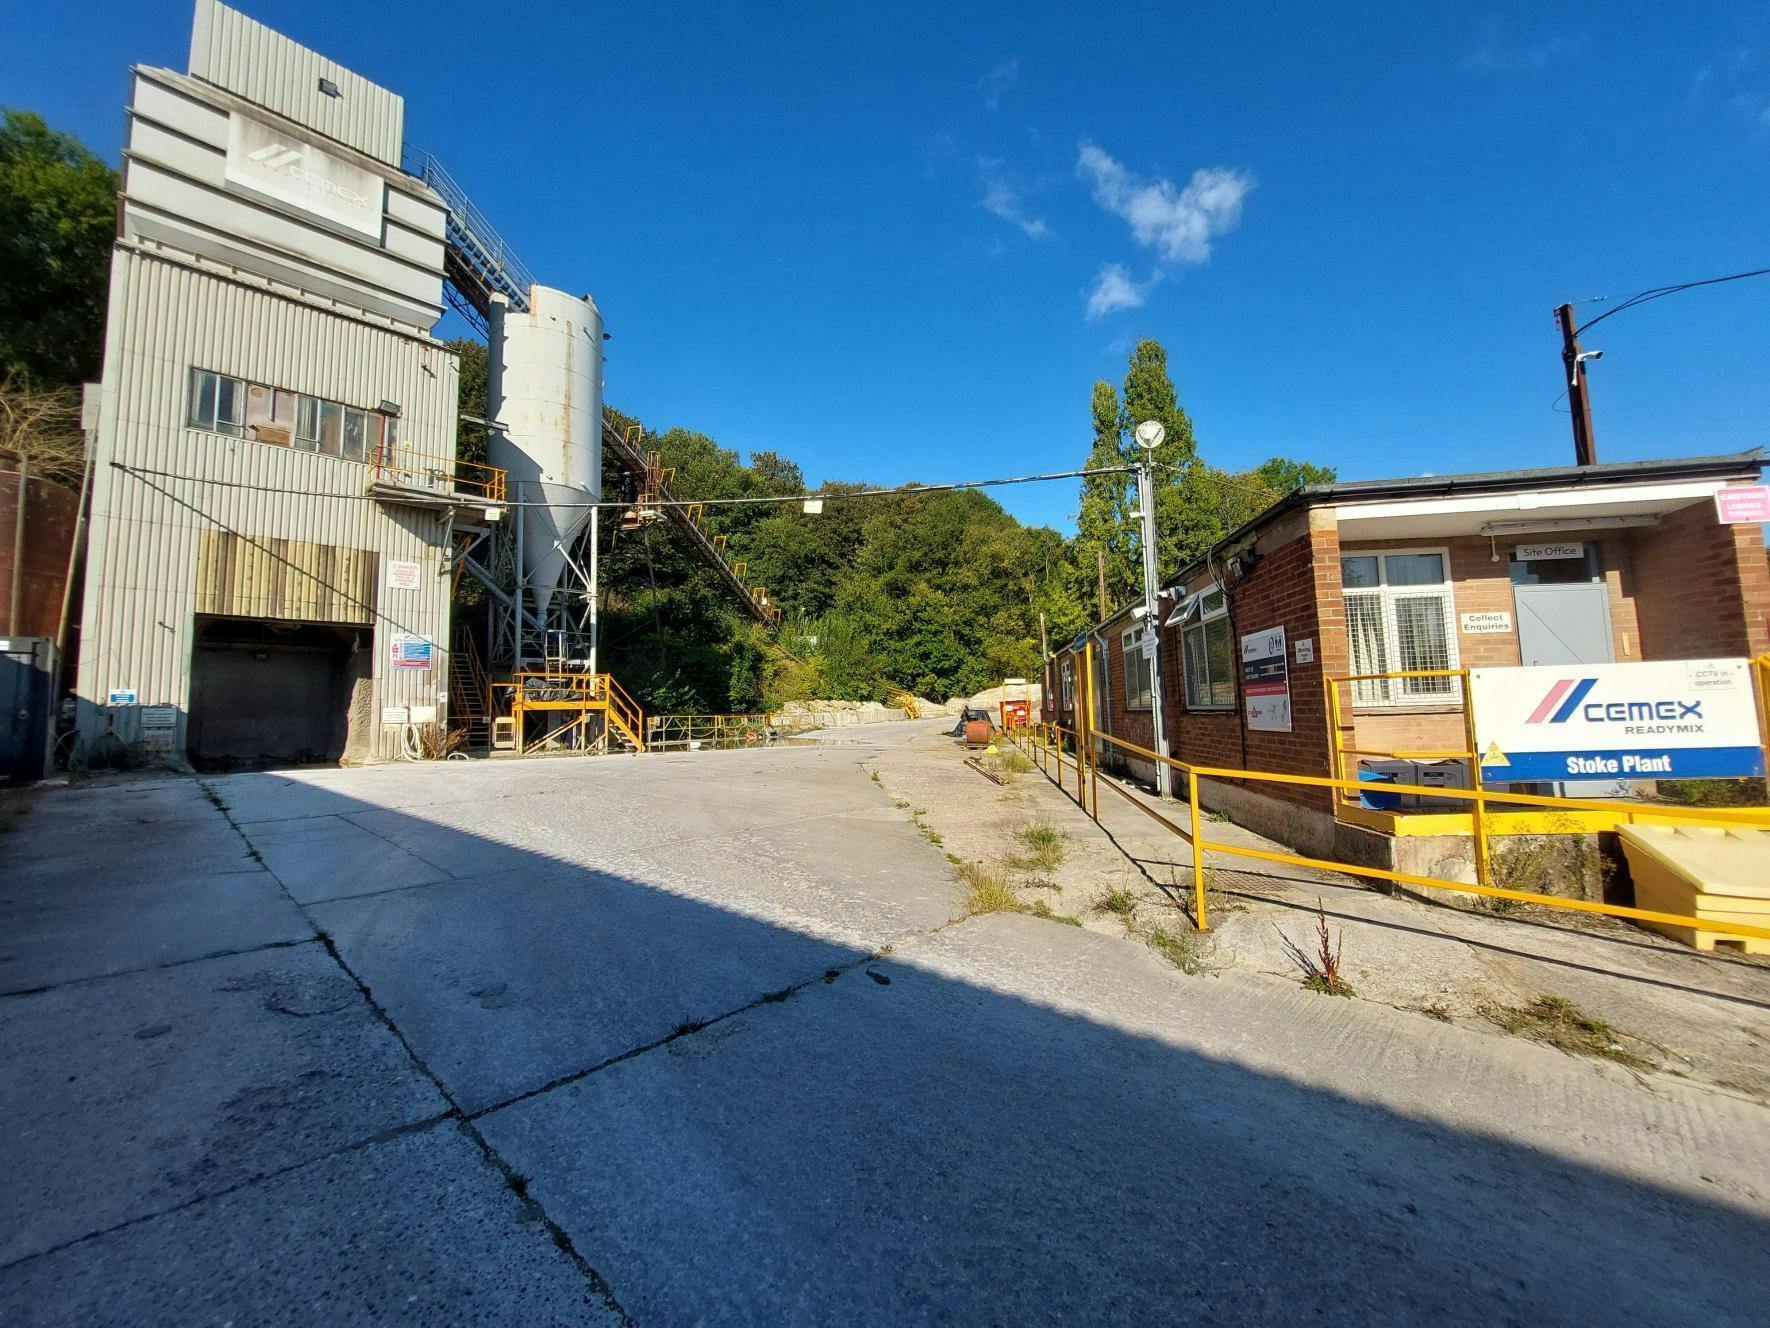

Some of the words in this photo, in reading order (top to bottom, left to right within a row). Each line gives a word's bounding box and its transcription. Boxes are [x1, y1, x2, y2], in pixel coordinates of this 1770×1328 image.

[1523, 548, 1542, 557] Site
[1544, 547, 1577, 556] Office
[1469, 614, 1503, 622] Collect
[1464, 623, 1509, 631] Enquiries
[1695, 670, 1719, 678] CCTV
[1694, 679, 1732, 688] operation
[1583, 700, 1703, 722] CEMEX
[1625, 724, 1705, 735] READYMIX
[1566, 756, 1619, 775] Stoke
[1622, 754, 1672, 773] Plant
